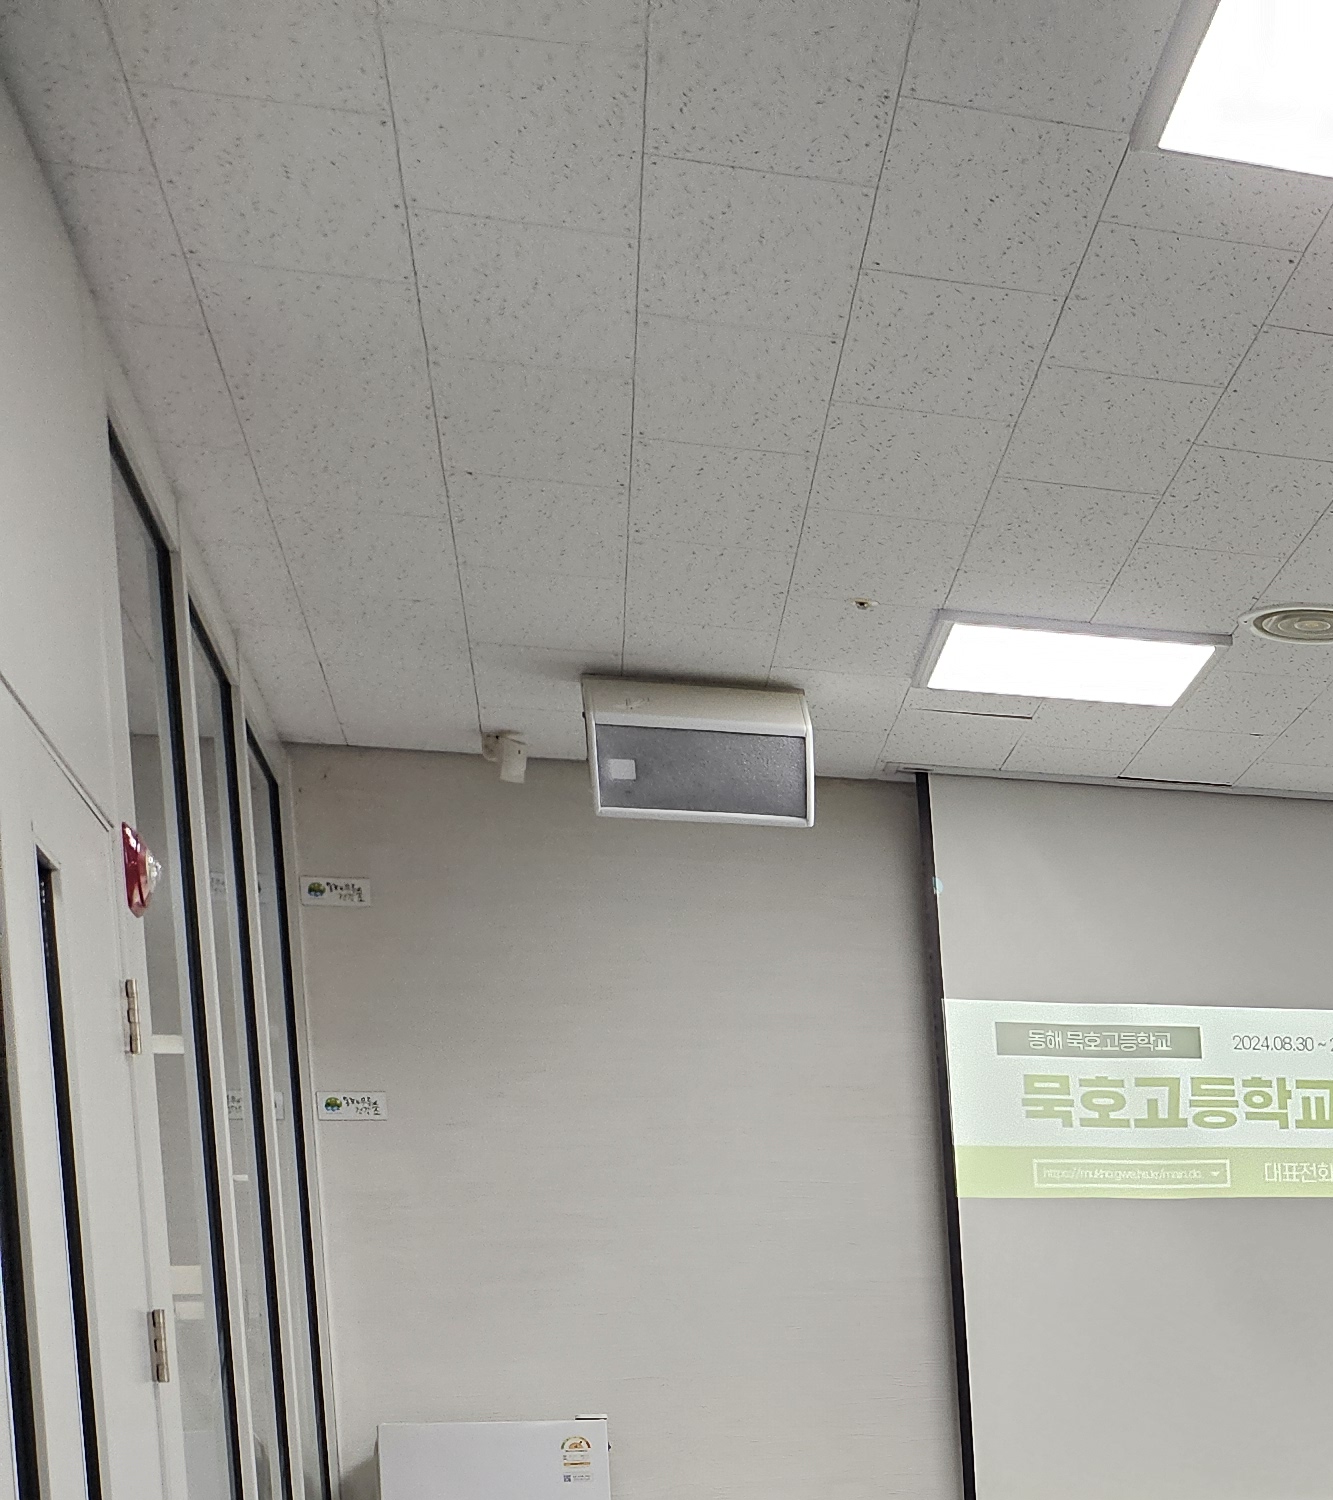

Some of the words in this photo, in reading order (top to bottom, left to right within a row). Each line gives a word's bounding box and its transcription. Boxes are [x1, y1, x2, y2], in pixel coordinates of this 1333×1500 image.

[1028, 1030, 1063, 1049] 동해
[1066, 1030, 1173, 1052] 묵호고등학교
[1232, 1034, 1315, 1053] 2024.08.30
